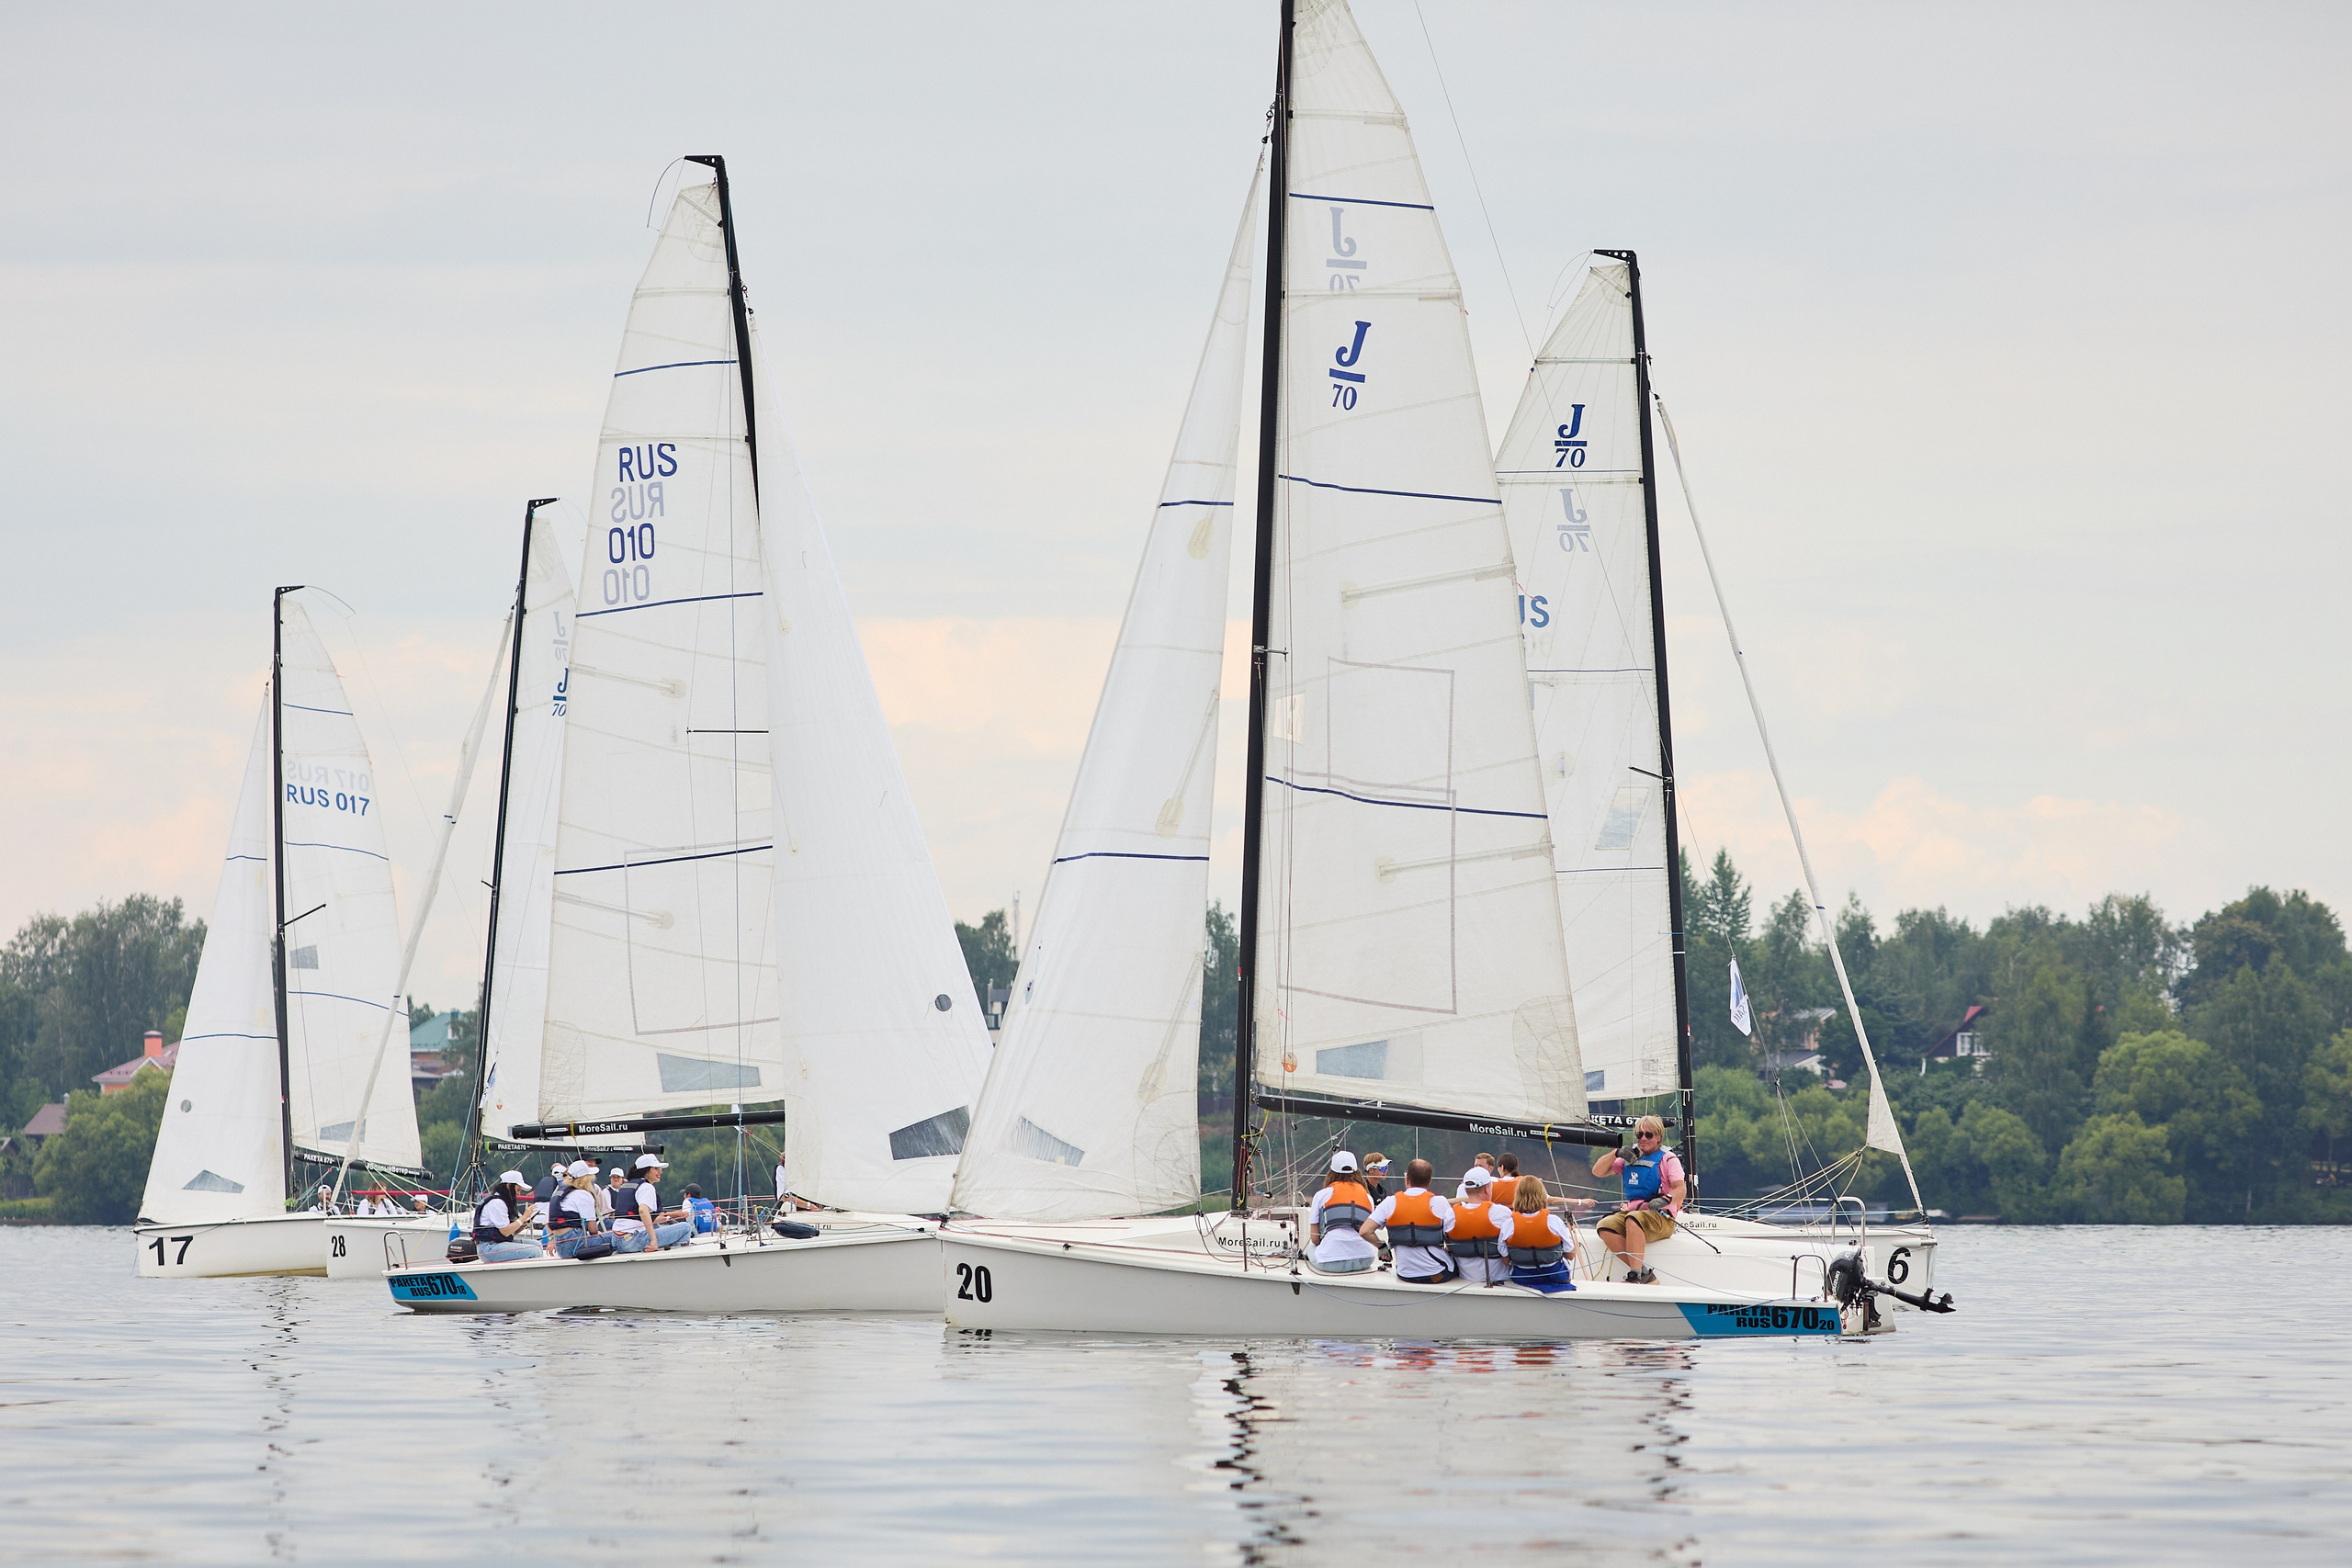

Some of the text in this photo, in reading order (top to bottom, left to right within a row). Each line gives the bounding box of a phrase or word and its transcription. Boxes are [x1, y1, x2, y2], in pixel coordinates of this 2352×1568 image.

[1335, 321, 1372, 367] J
[1332, 383, 1358, 411] 70
[1557, 403, 1586, 439] J
[618, 443, 678, 482] RUS
[1555, 448, 1586, 468] 70
[608, 523, 655, 564] 010
[552, 703, 567, 716] 70
[287, 784, 369, 816] RUS 017
[579, 1123, 628, 1133] MoreSail.ru
[1469, 1123, 1528, 1138] MoreSail.ru
[1590, 1114, 1641, 1125] КЕТА 67
[148, 1235, 194, 1267] 17
[331, 1235, 346, 1258] 28
[1888, 1247, 1911, 1284] 6
[410, 1285, 467, 1297] RUS 18
[426, 1275, 458, 1296] 670
[956, 1262, 992, 1303] 20
[1736, 1317, 1835, 1330] RUS 20
[1771, 1307, 1819, 1329] 670
